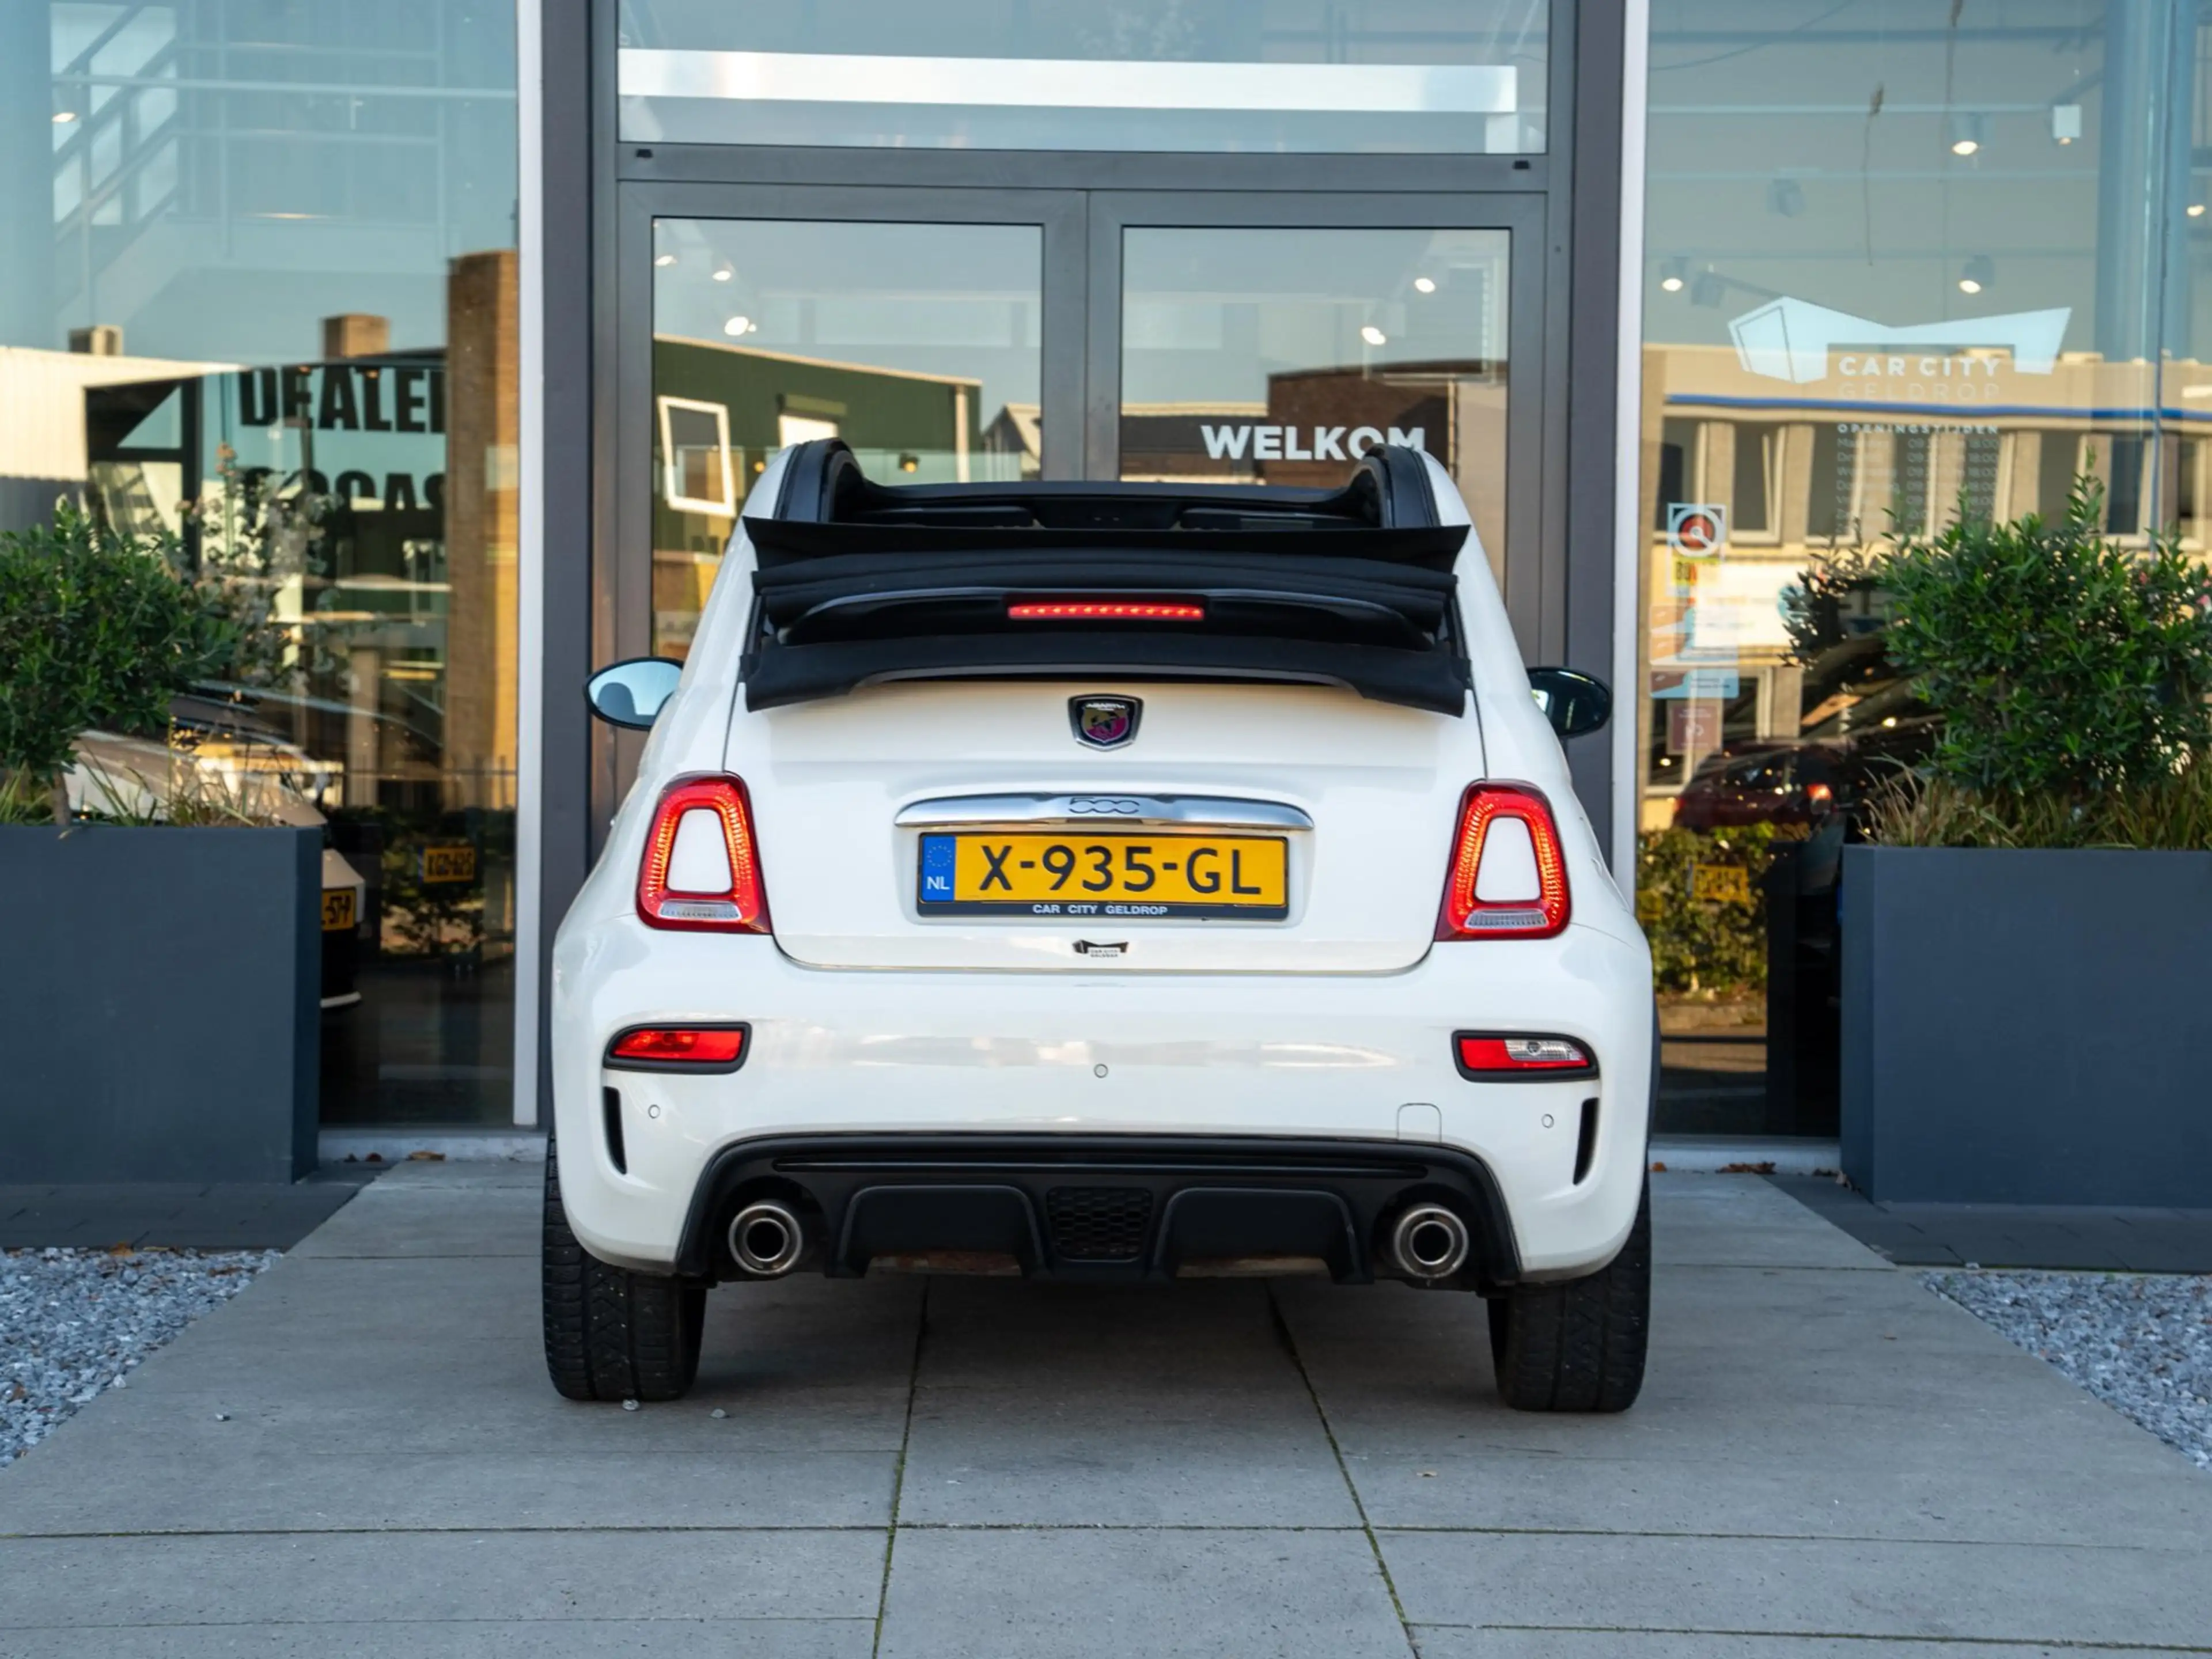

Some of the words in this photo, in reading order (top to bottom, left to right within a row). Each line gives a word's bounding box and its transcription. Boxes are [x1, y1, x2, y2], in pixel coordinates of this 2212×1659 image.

[1838, 355, 1906, 377] CAR
[1919, 355, 2000, 377] CITY
[1838, 382, 1999, 402] GELDROP
[1200, 425, 1426, 461] WELKOM
[1069, 797, 1140, 815] 500
[926, 877, 950, 891] NL
[979, 844, 1262, 895] X-935-GL
[1032, 904, 1060, 914] CAR
[1067, 904, 1098, 915] CITY
[1105, 904, 1168, 915] GELDROP
